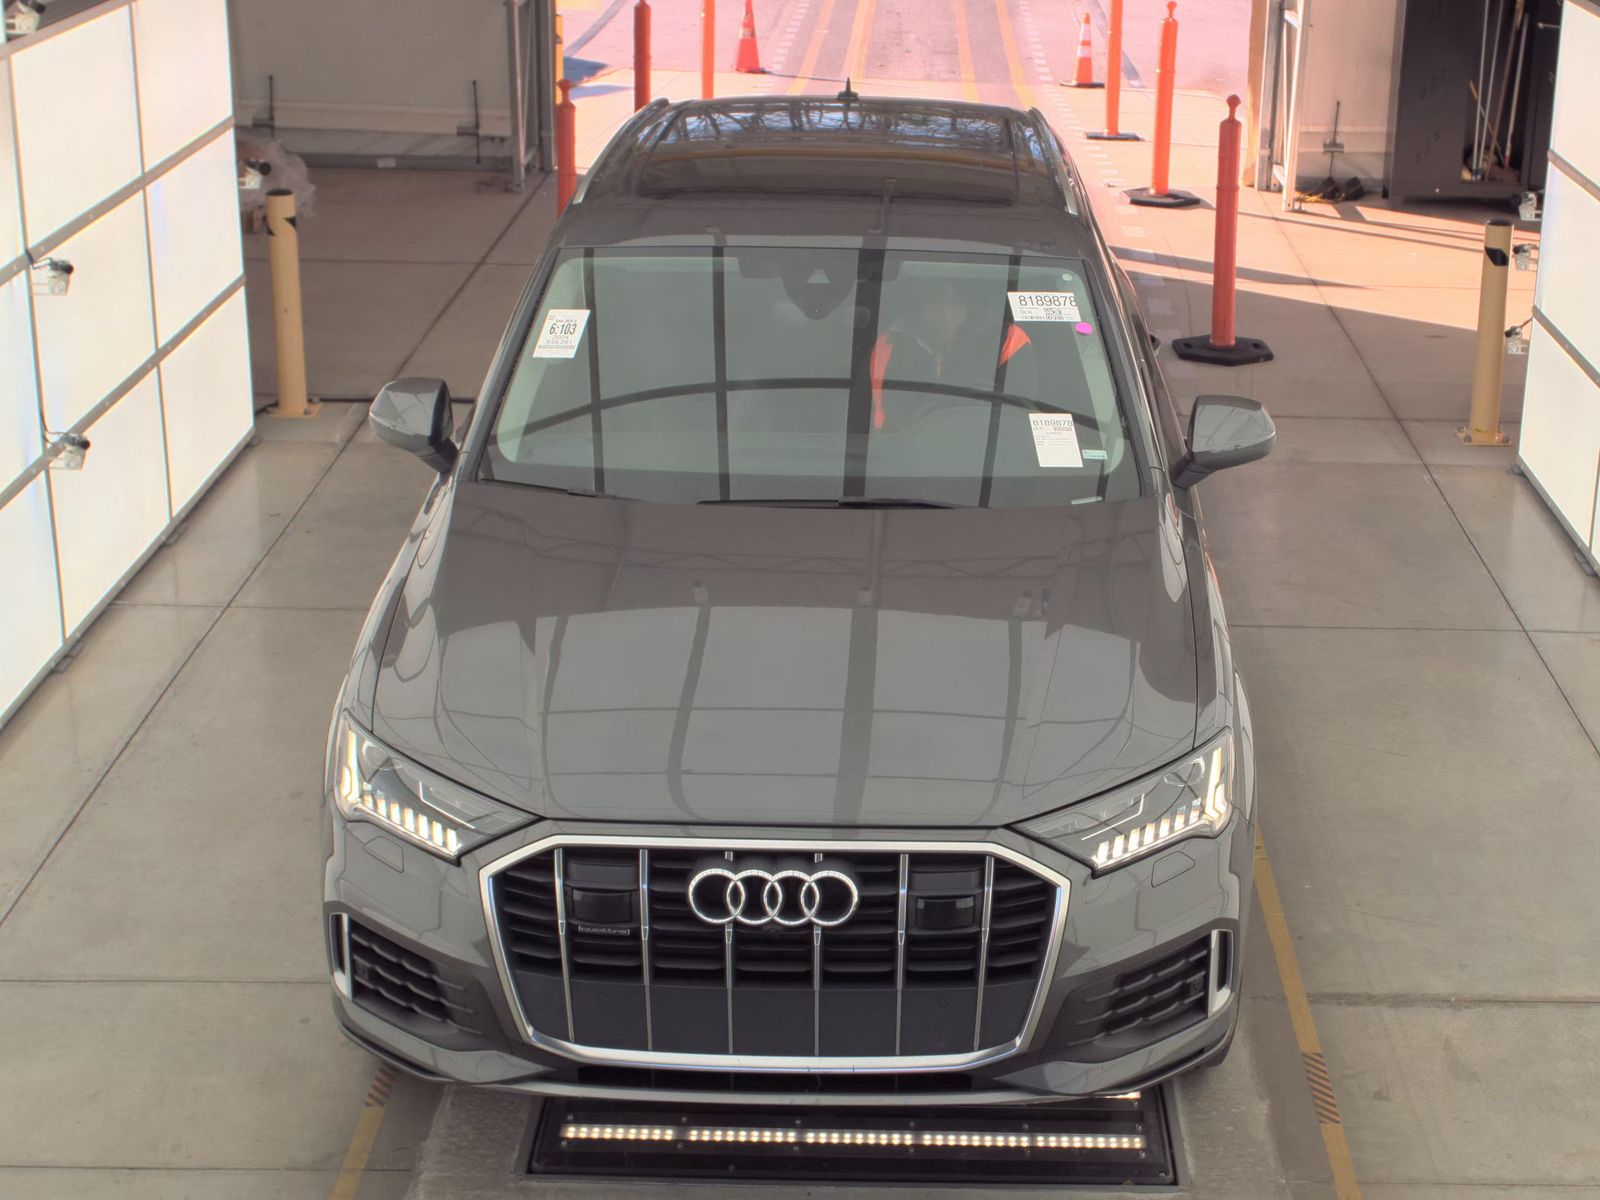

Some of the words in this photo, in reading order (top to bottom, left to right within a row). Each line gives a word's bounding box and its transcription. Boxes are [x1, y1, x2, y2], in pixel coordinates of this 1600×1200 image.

[1018, 295, 1077, 306] 8189878
[549, 323, 577, 335] 6:103
[1032, 419, 1073, 427] 8189878
